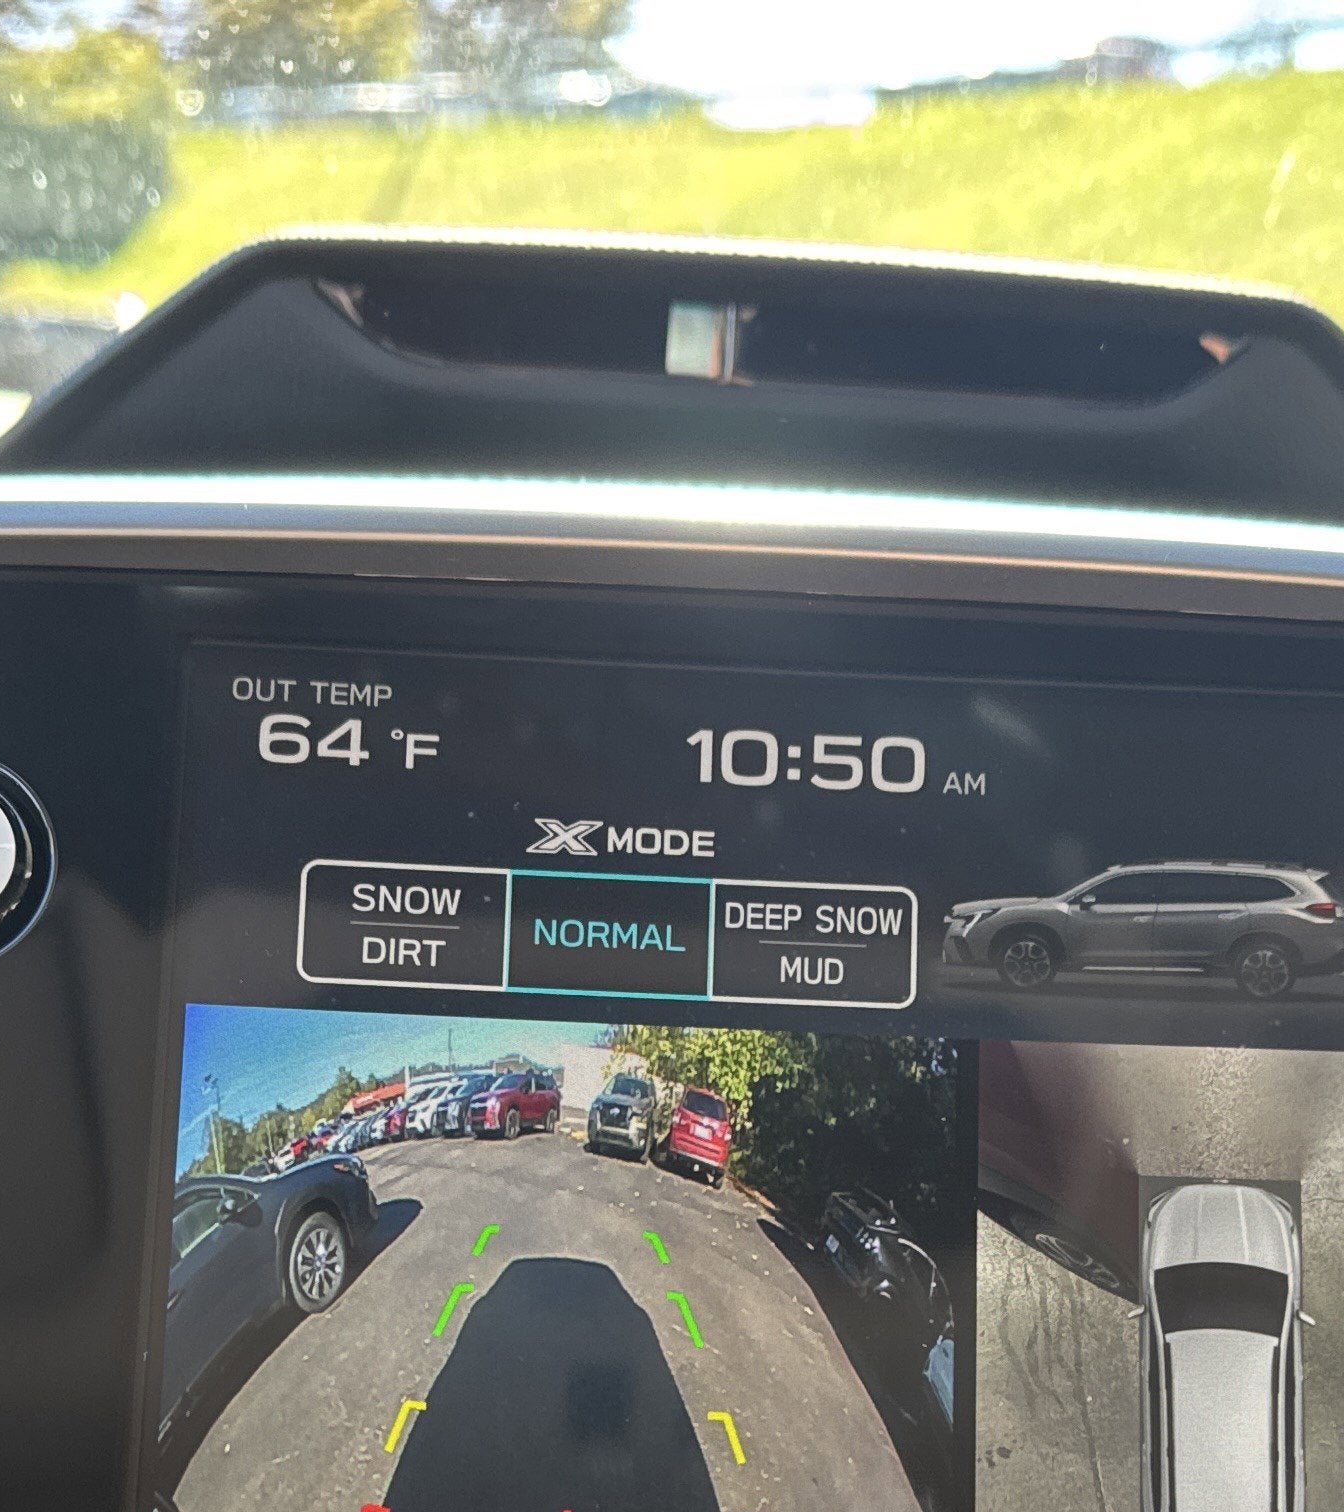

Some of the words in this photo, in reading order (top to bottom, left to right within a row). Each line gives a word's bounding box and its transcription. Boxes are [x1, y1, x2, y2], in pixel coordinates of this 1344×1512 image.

[231, 676, 297, 704] OUT
[310, 681, 393, 707] TEMP
[258, 713, 370, 767] 64
[686, 729, 927, 794] 10:50
[942, 771, 988, 796] AM
[606, 827, 716, 858] MODE
[351, 883, 461, 916] SNOW
[533, 918, 686, 953] NORMAL
[724, 902, 802, 933] DEEP
[815, 906, 903, 937] SNOW
[361, 936, 447, 968] DIRT
[779, 956, 846, 986] MUD
